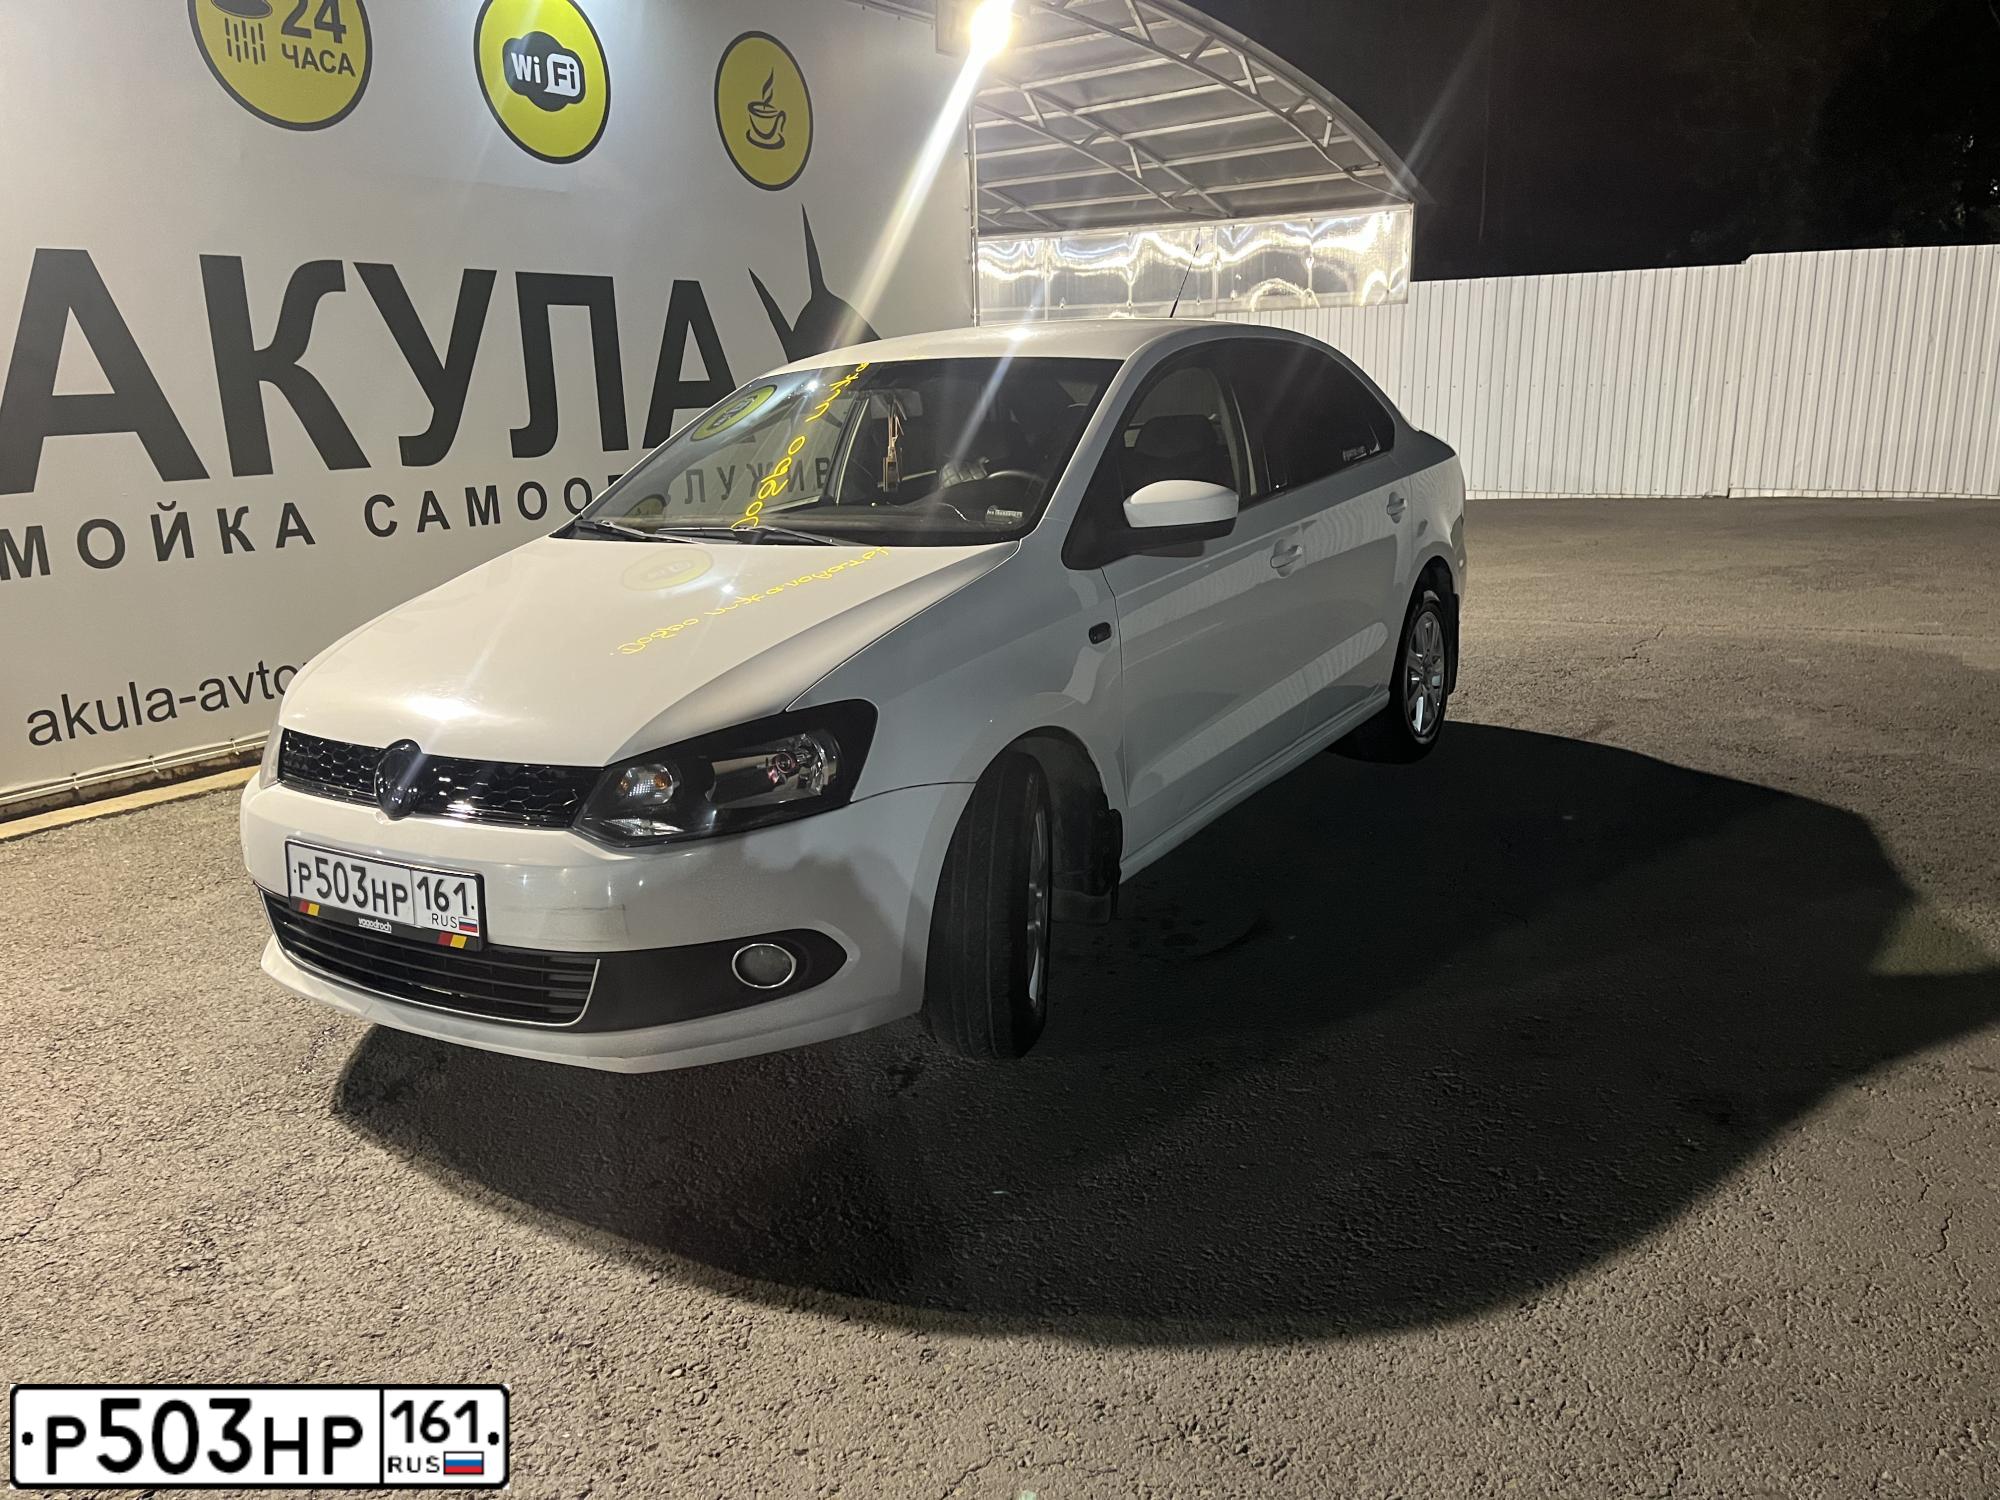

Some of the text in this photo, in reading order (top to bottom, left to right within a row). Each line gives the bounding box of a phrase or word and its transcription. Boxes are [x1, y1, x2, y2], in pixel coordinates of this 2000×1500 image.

[281, 0, 347, 44] 24
[281, 44, 356, 77] ЧАСА
[0, 247, 740, 495] АКУЛА
[0, 500, 316, 580] МОЙКА
[27, 659, 307, 746] akula-avto
[298, 856, 468, 917] Р503НР 161
[431, 913, 458, 929] RUS
